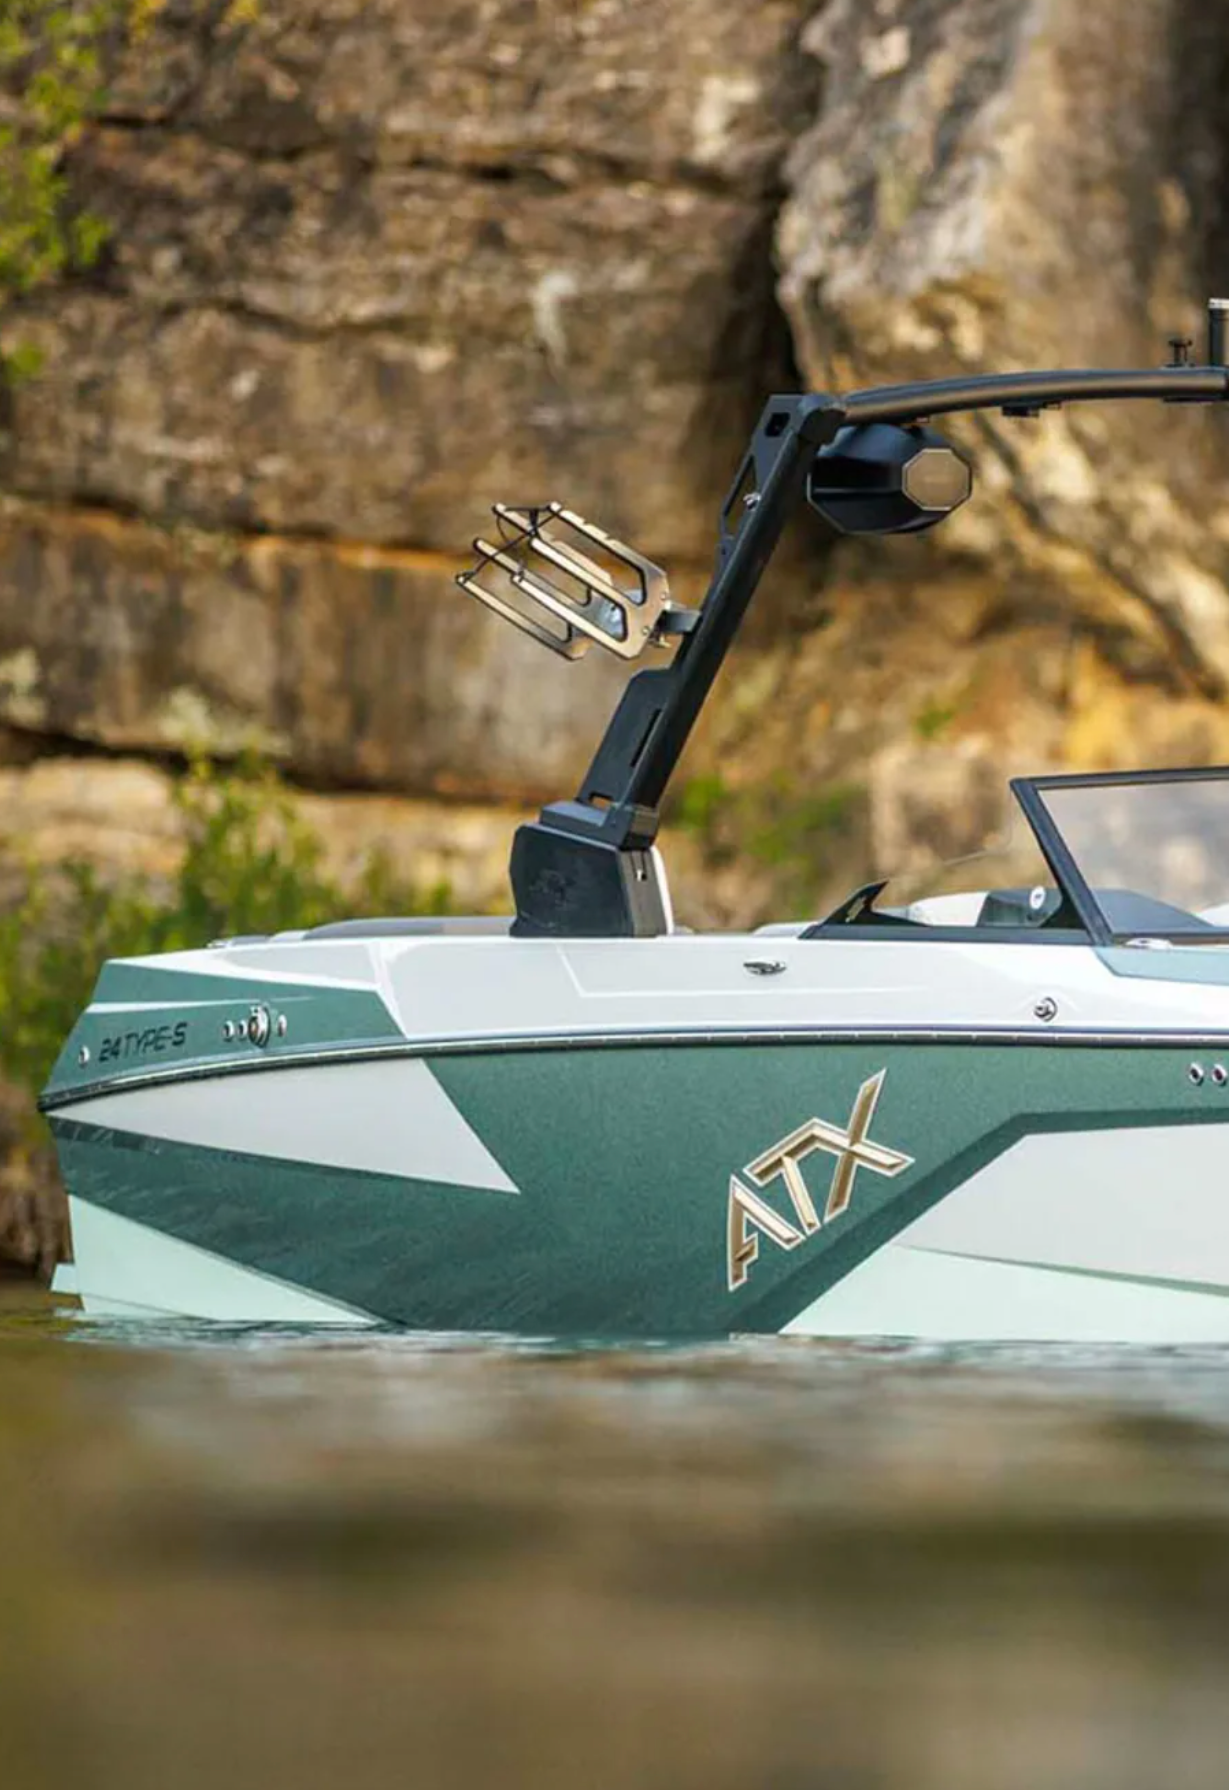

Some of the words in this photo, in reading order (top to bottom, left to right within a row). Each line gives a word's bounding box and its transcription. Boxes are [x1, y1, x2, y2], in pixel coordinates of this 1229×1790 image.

[98, 1036, 121, 1062] 24
[125, 1021, 188, 1059] TYPE-S
[727, 1067, 915, 1292] ATX
